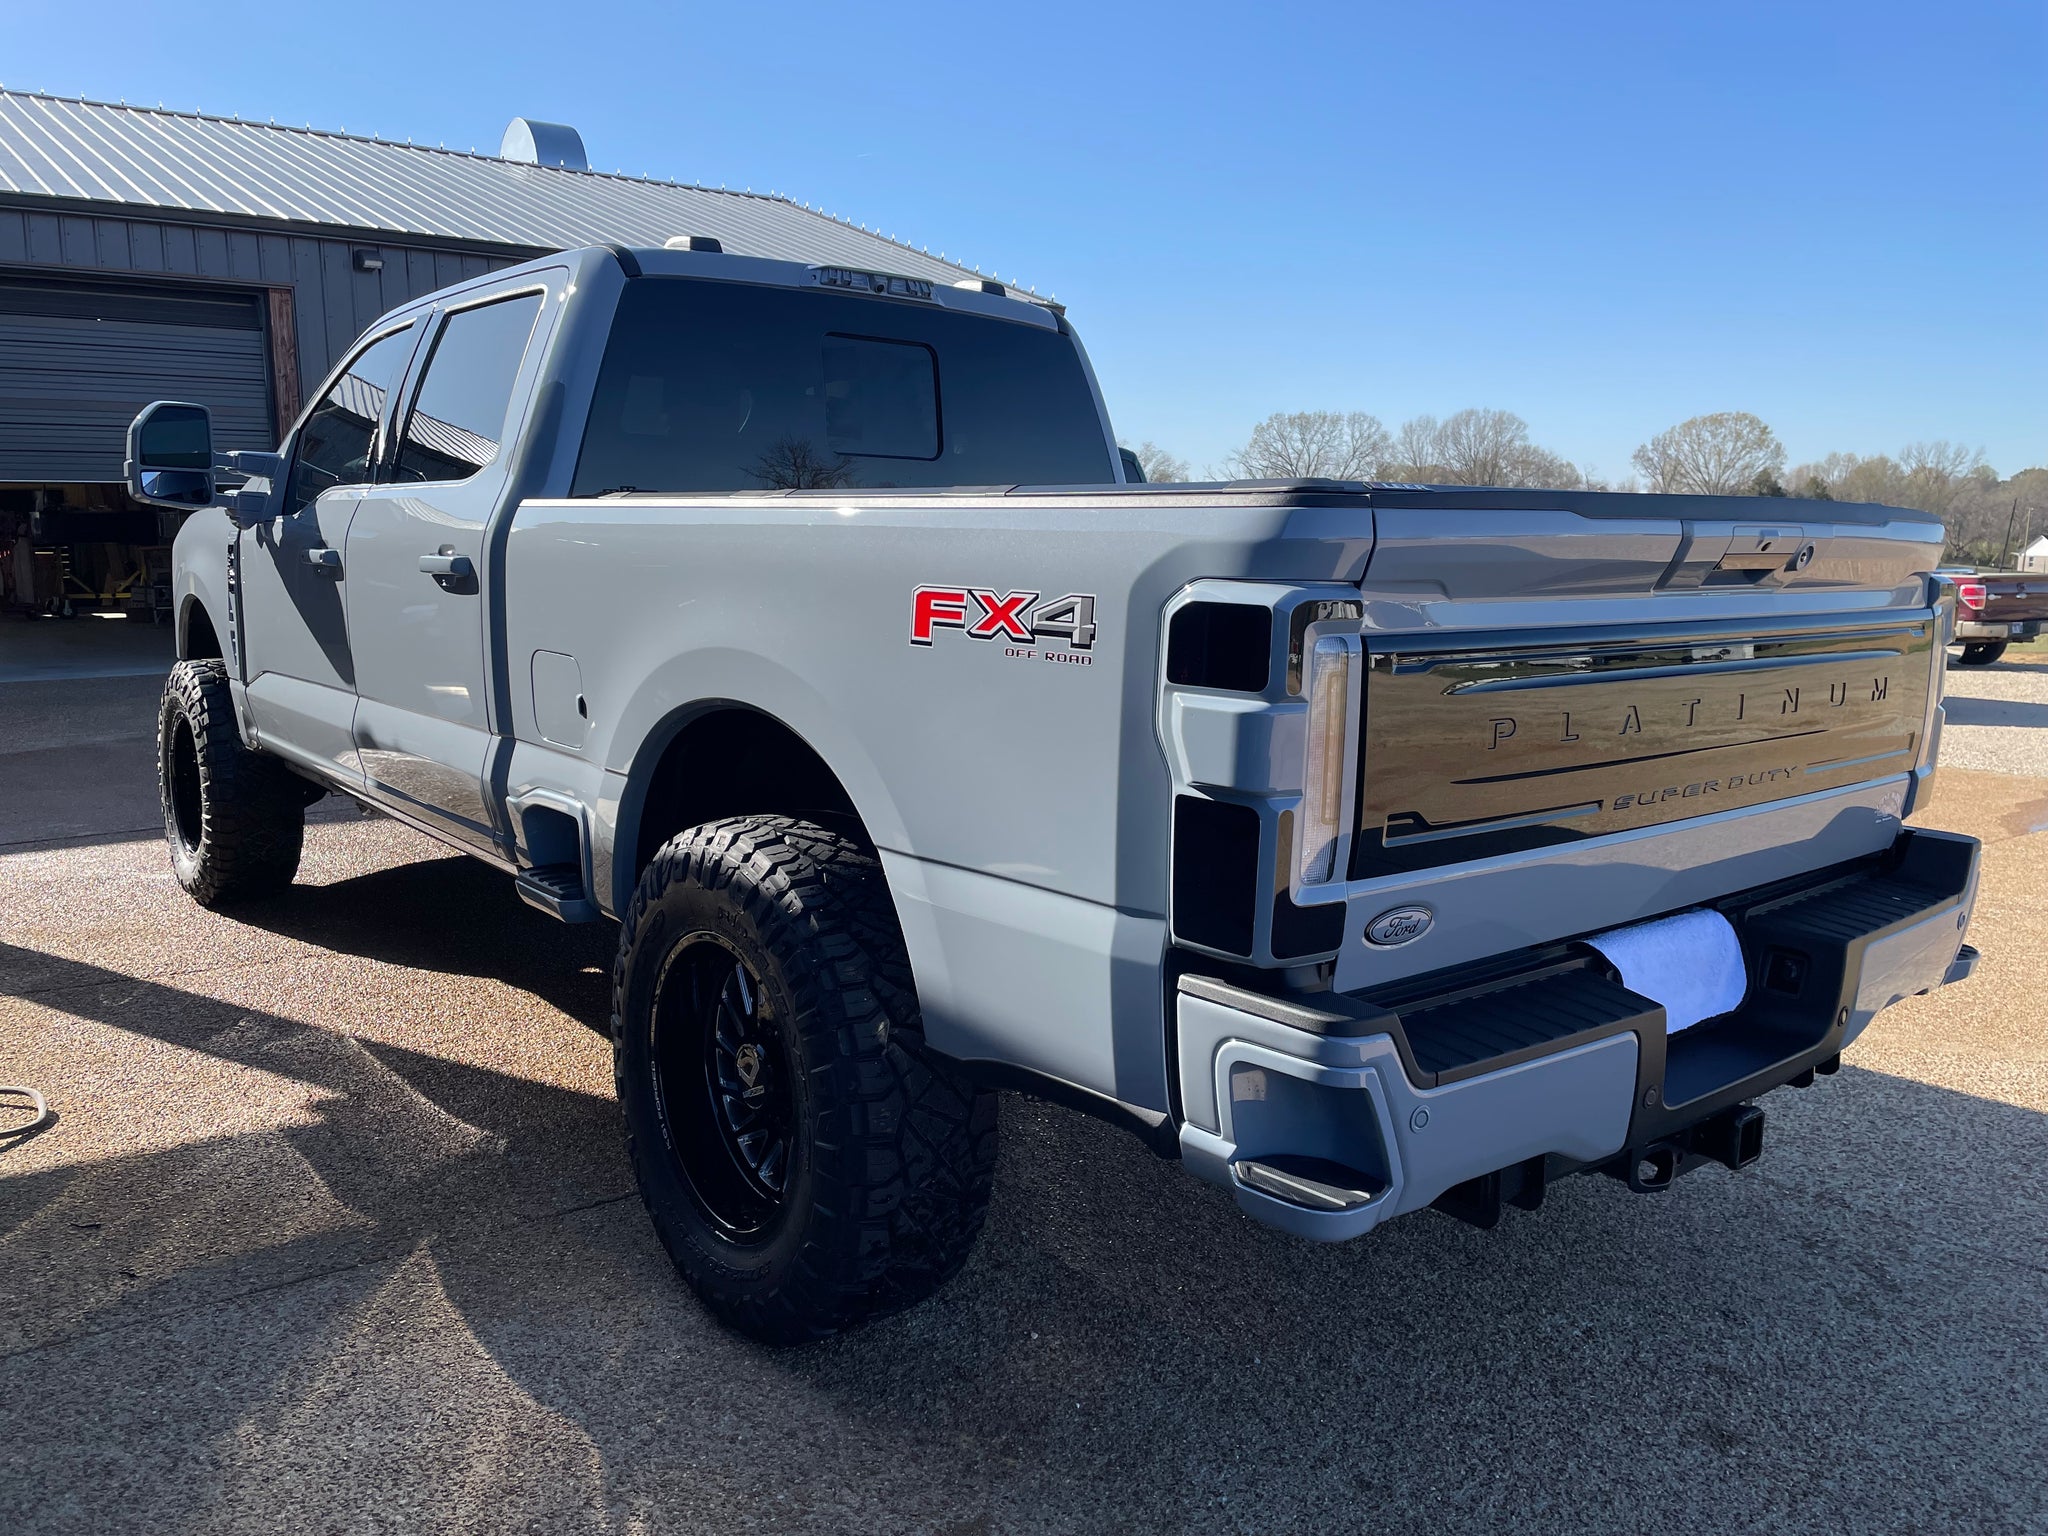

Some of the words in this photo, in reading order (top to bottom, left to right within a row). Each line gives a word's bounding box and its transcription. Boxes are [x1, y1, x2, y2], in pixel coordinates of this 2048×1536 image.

[910, 584, 1097, 651] FX4
[1005, 647, 1038, 660] OFF
[1045, 651, 1093, 666] ROAD
[1487, 676, 1889, 750] PLATINUM
[1612, 779, 1721, 811] SUPER
[1728, 765, 1798, 790] DUTY
[1383, 914, 1422, 939] Ford
